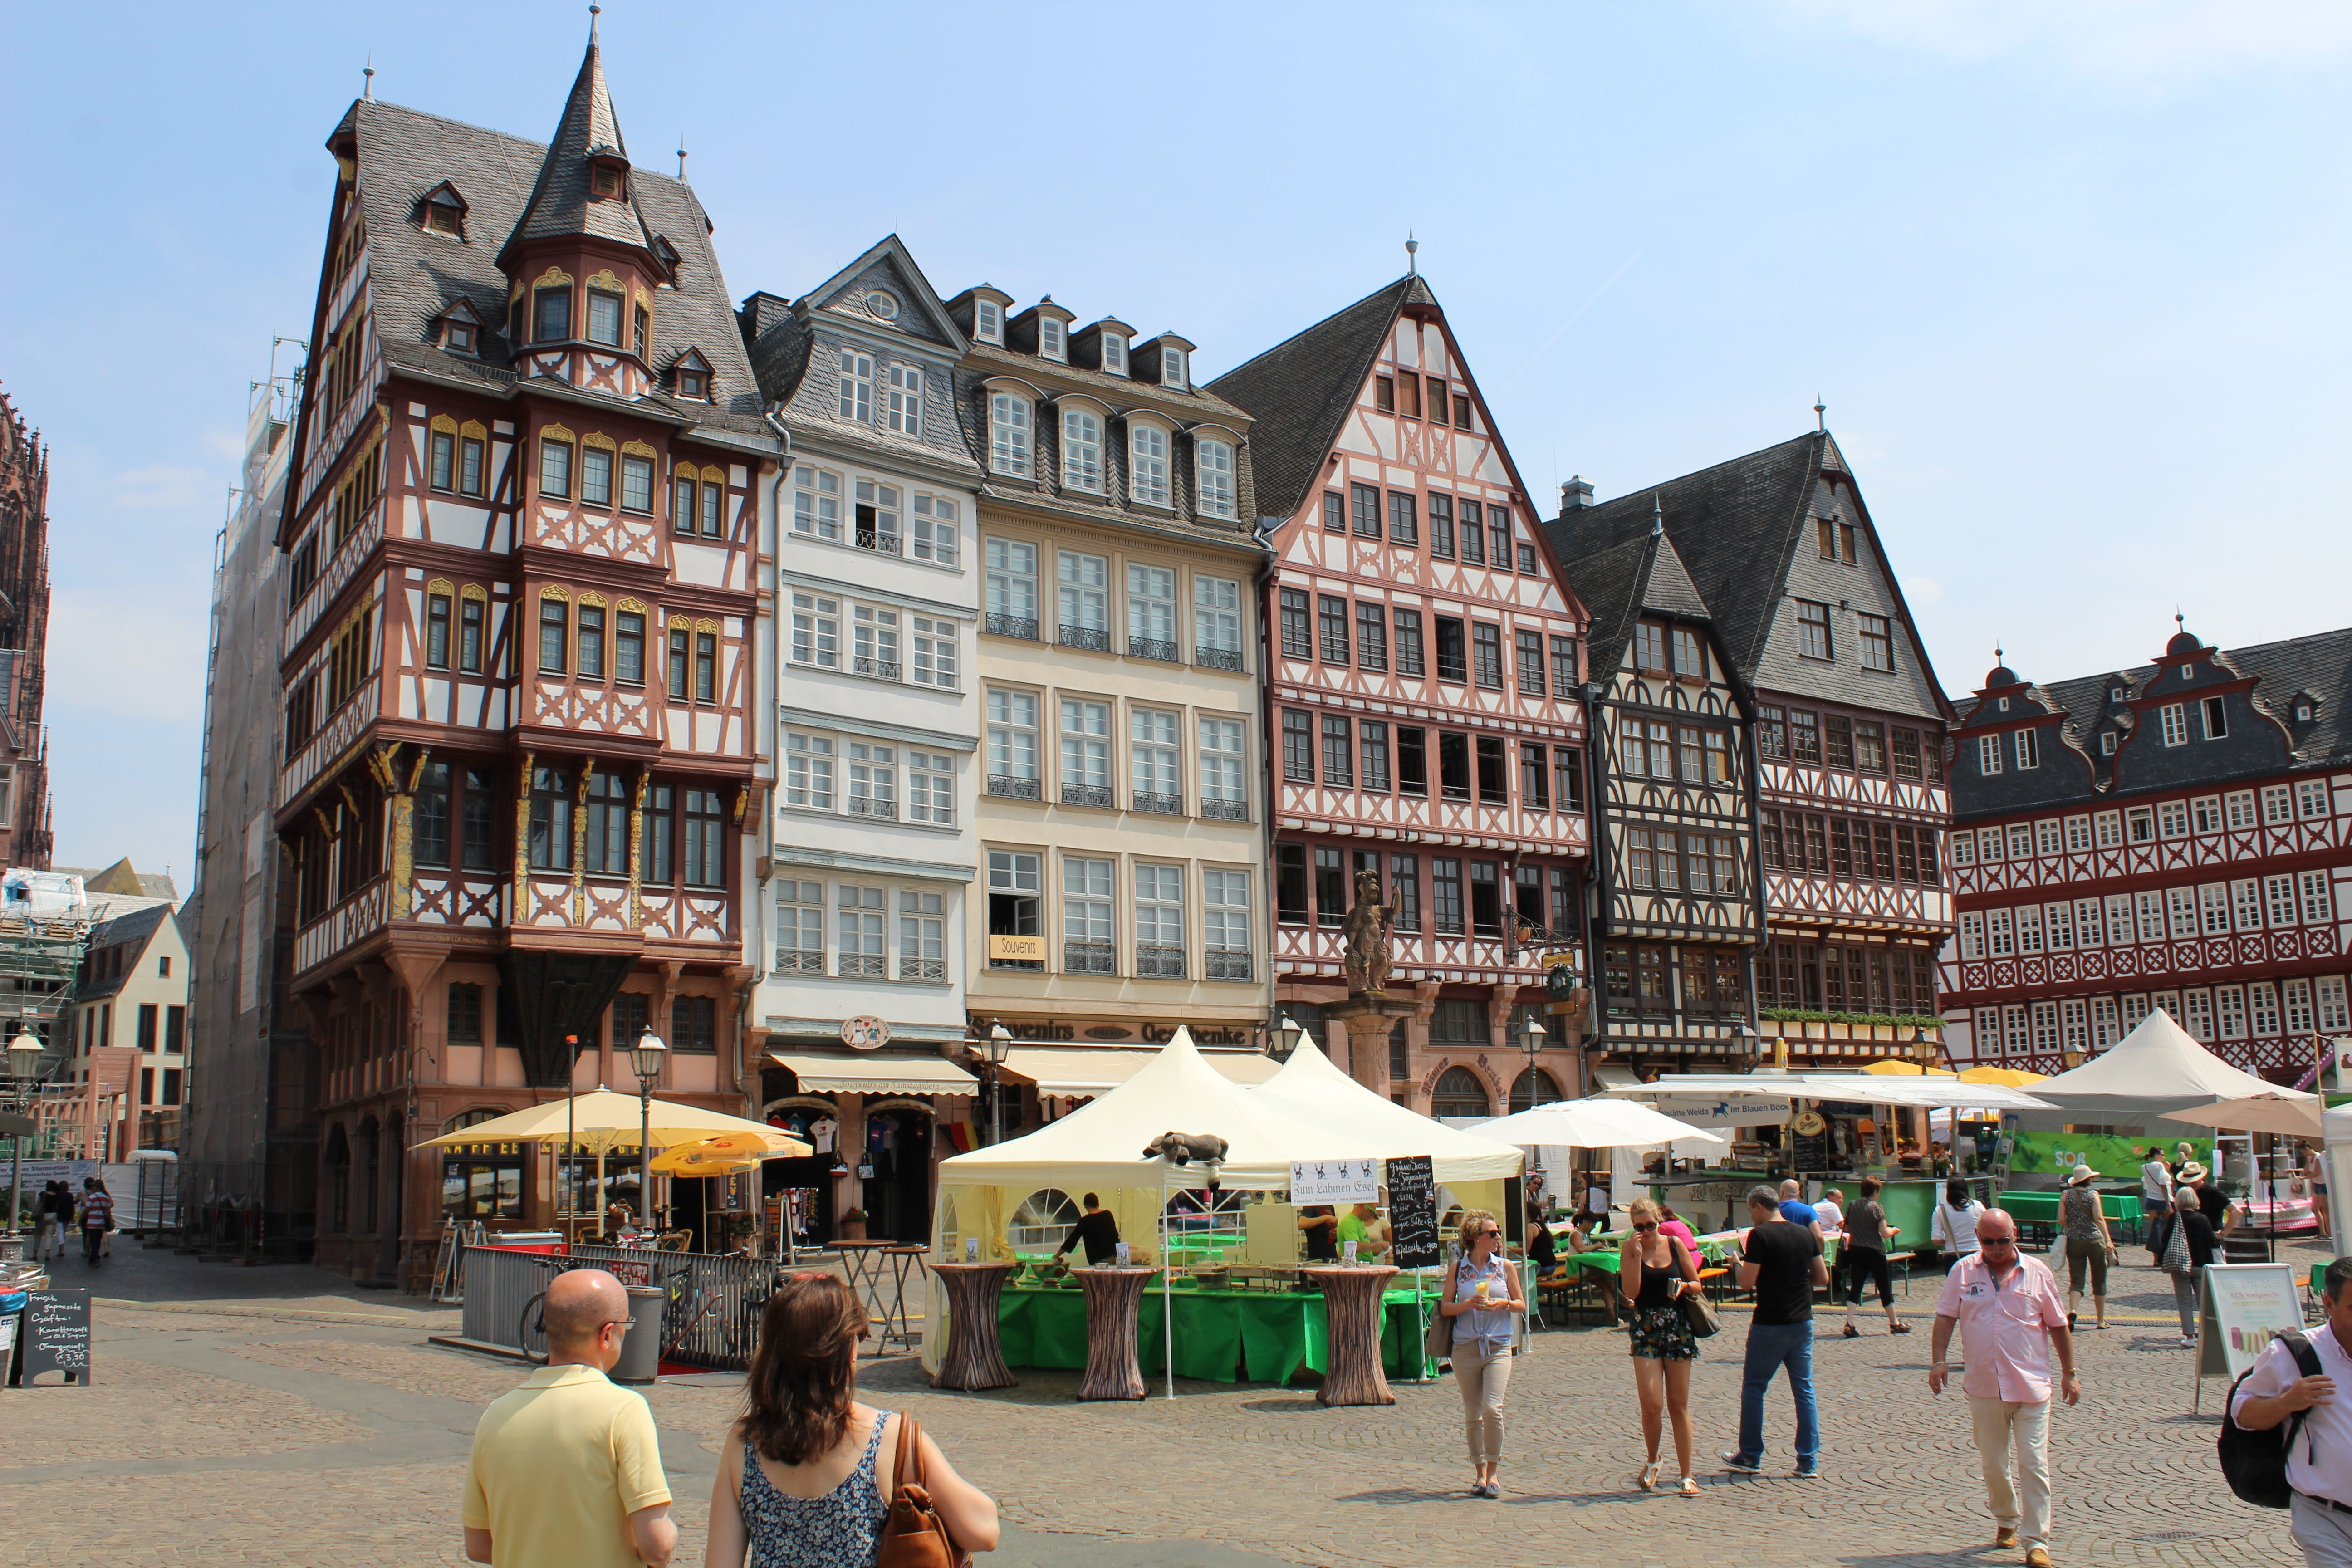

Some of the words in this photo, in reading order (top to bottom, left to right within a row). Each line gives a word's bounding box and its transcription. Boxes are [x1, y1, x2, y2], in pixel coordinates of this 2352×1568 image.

[1002, 937, 1036, 954] Souvenirs
[1142, 1023, 1246, 1044] Gehenke
[841, 1080, 877, 1088] Souvenirs
[892, 1081, 940, 1092] Samstagsberg
[444, 1142, 519, 1154] KAFFEE
[540, 1143, 551, 1153] &
[558, 1143, 640, 1154] CHAGE
[1294, 1183, 1313, 1197] Zum
[1316, 1182, 1351, 1196] Lahmen
[1354, 1180, 1375, 1192] Esel
[1397, 1191, 1414, 1201] dazu
[2221, 1278, 2236, 1289] Eis
[2241, 1279, 2257, 1289] am
[2261, 1277, 2284, 1289] Stiel
[29, 1293, 58, 1302] Frisch
[44, 1302, 82, 1313] gepresste
